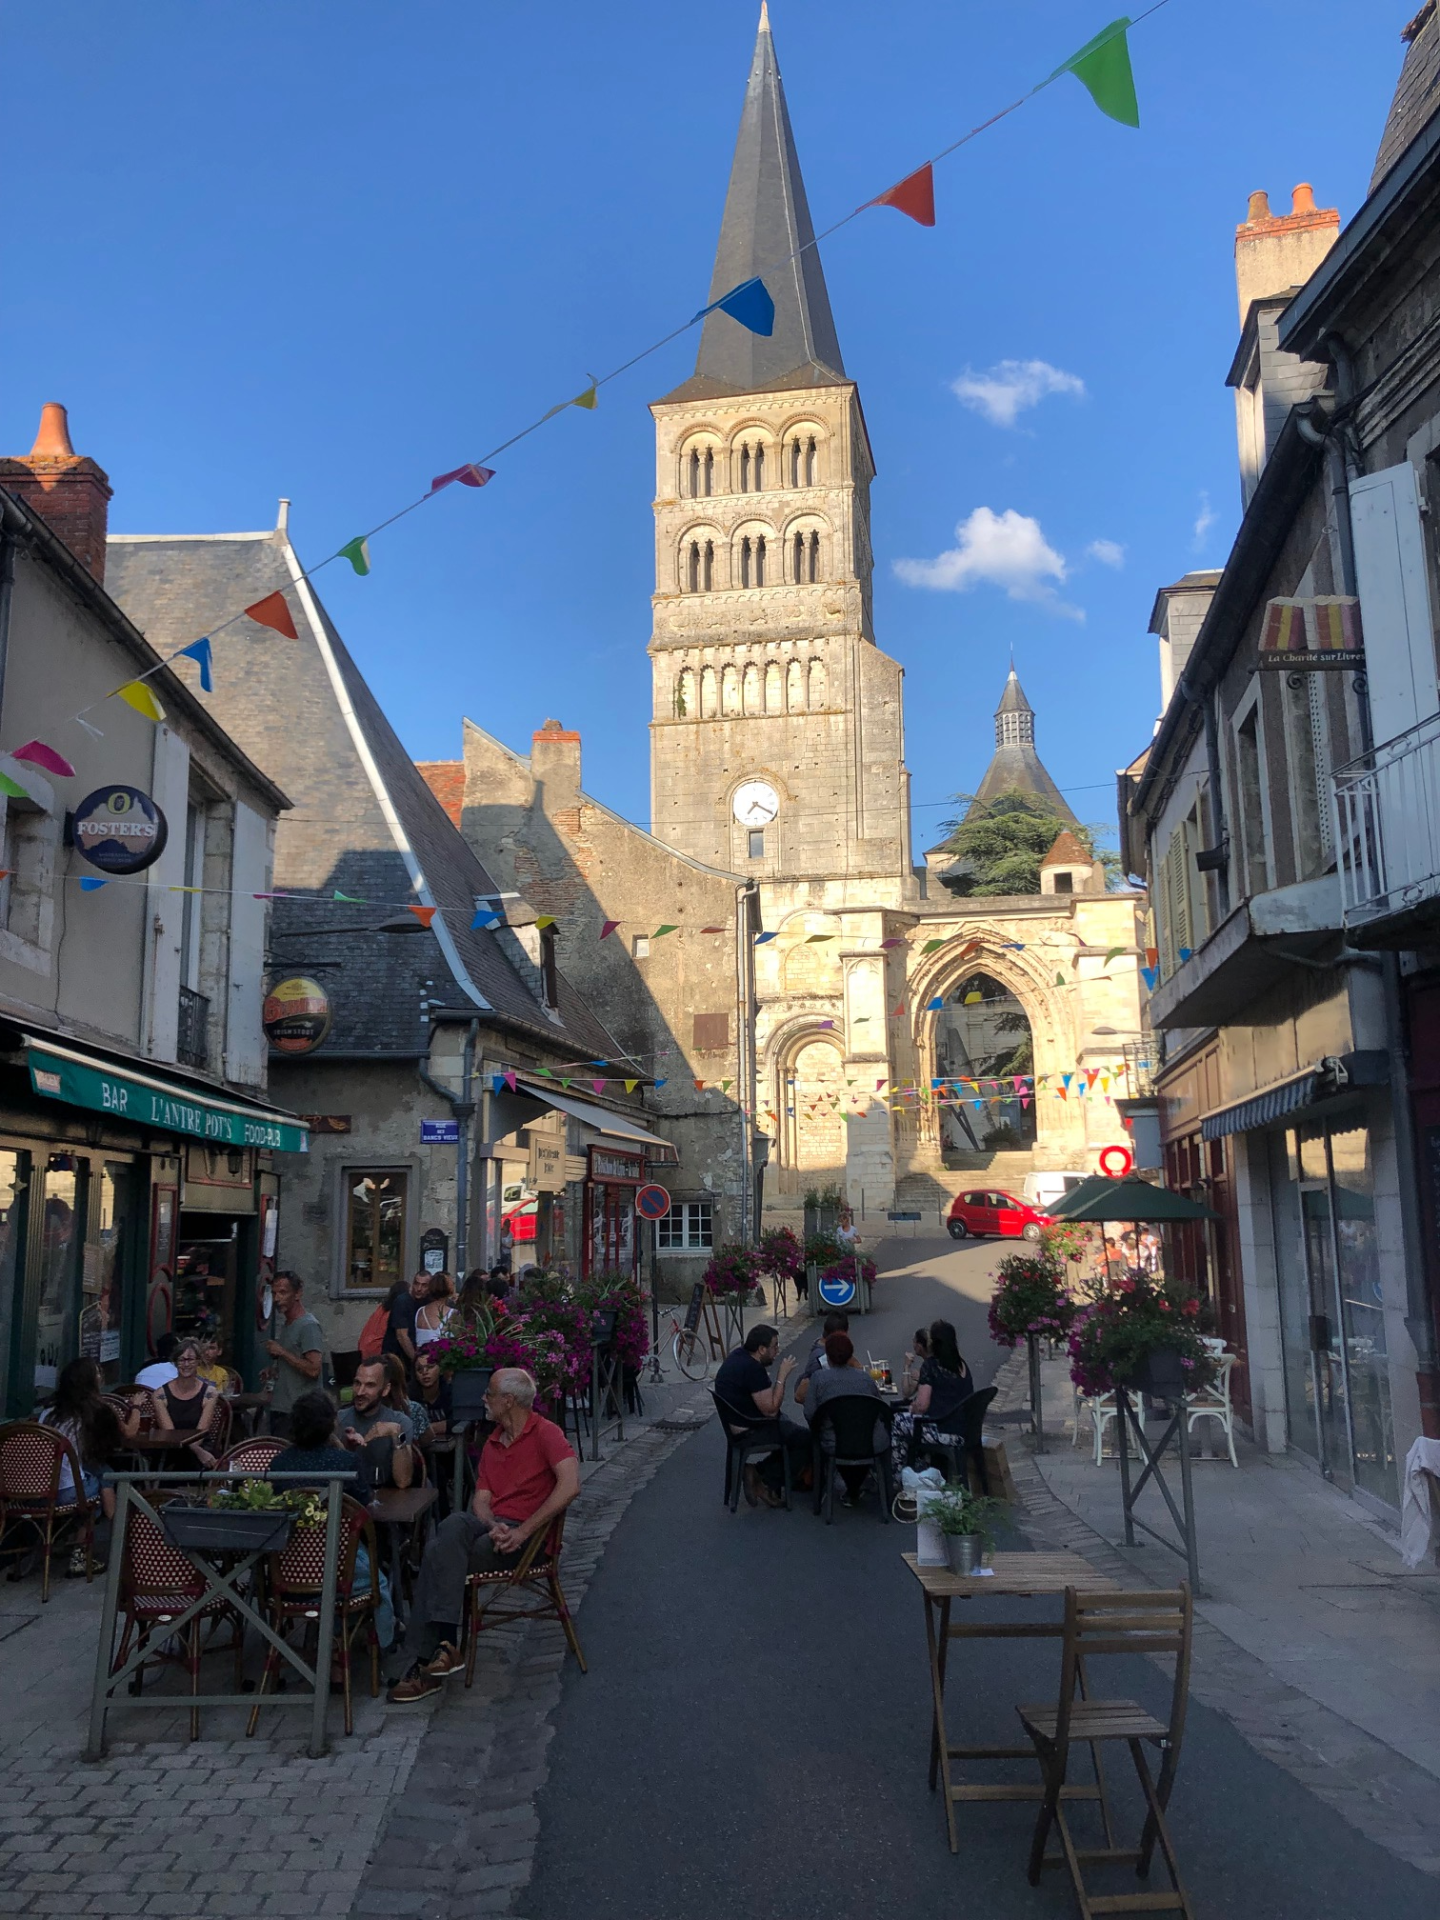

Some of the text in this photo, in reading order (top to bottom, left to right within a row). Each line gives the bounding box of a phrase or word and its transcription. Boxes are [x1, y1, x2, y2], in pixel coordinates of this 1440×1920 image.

[1268, 652, 1366, 662] La Charité sur Livres
[77, 821, 156, 837] FOSTER'S
[102, 1082, 128, 1112] BAR
[151, 1096, 201, 1133] L'ANTRE
[205, 1113, 232, 1139] POT'S
[244, 1123, 281, 1147] FOOD-PUB
